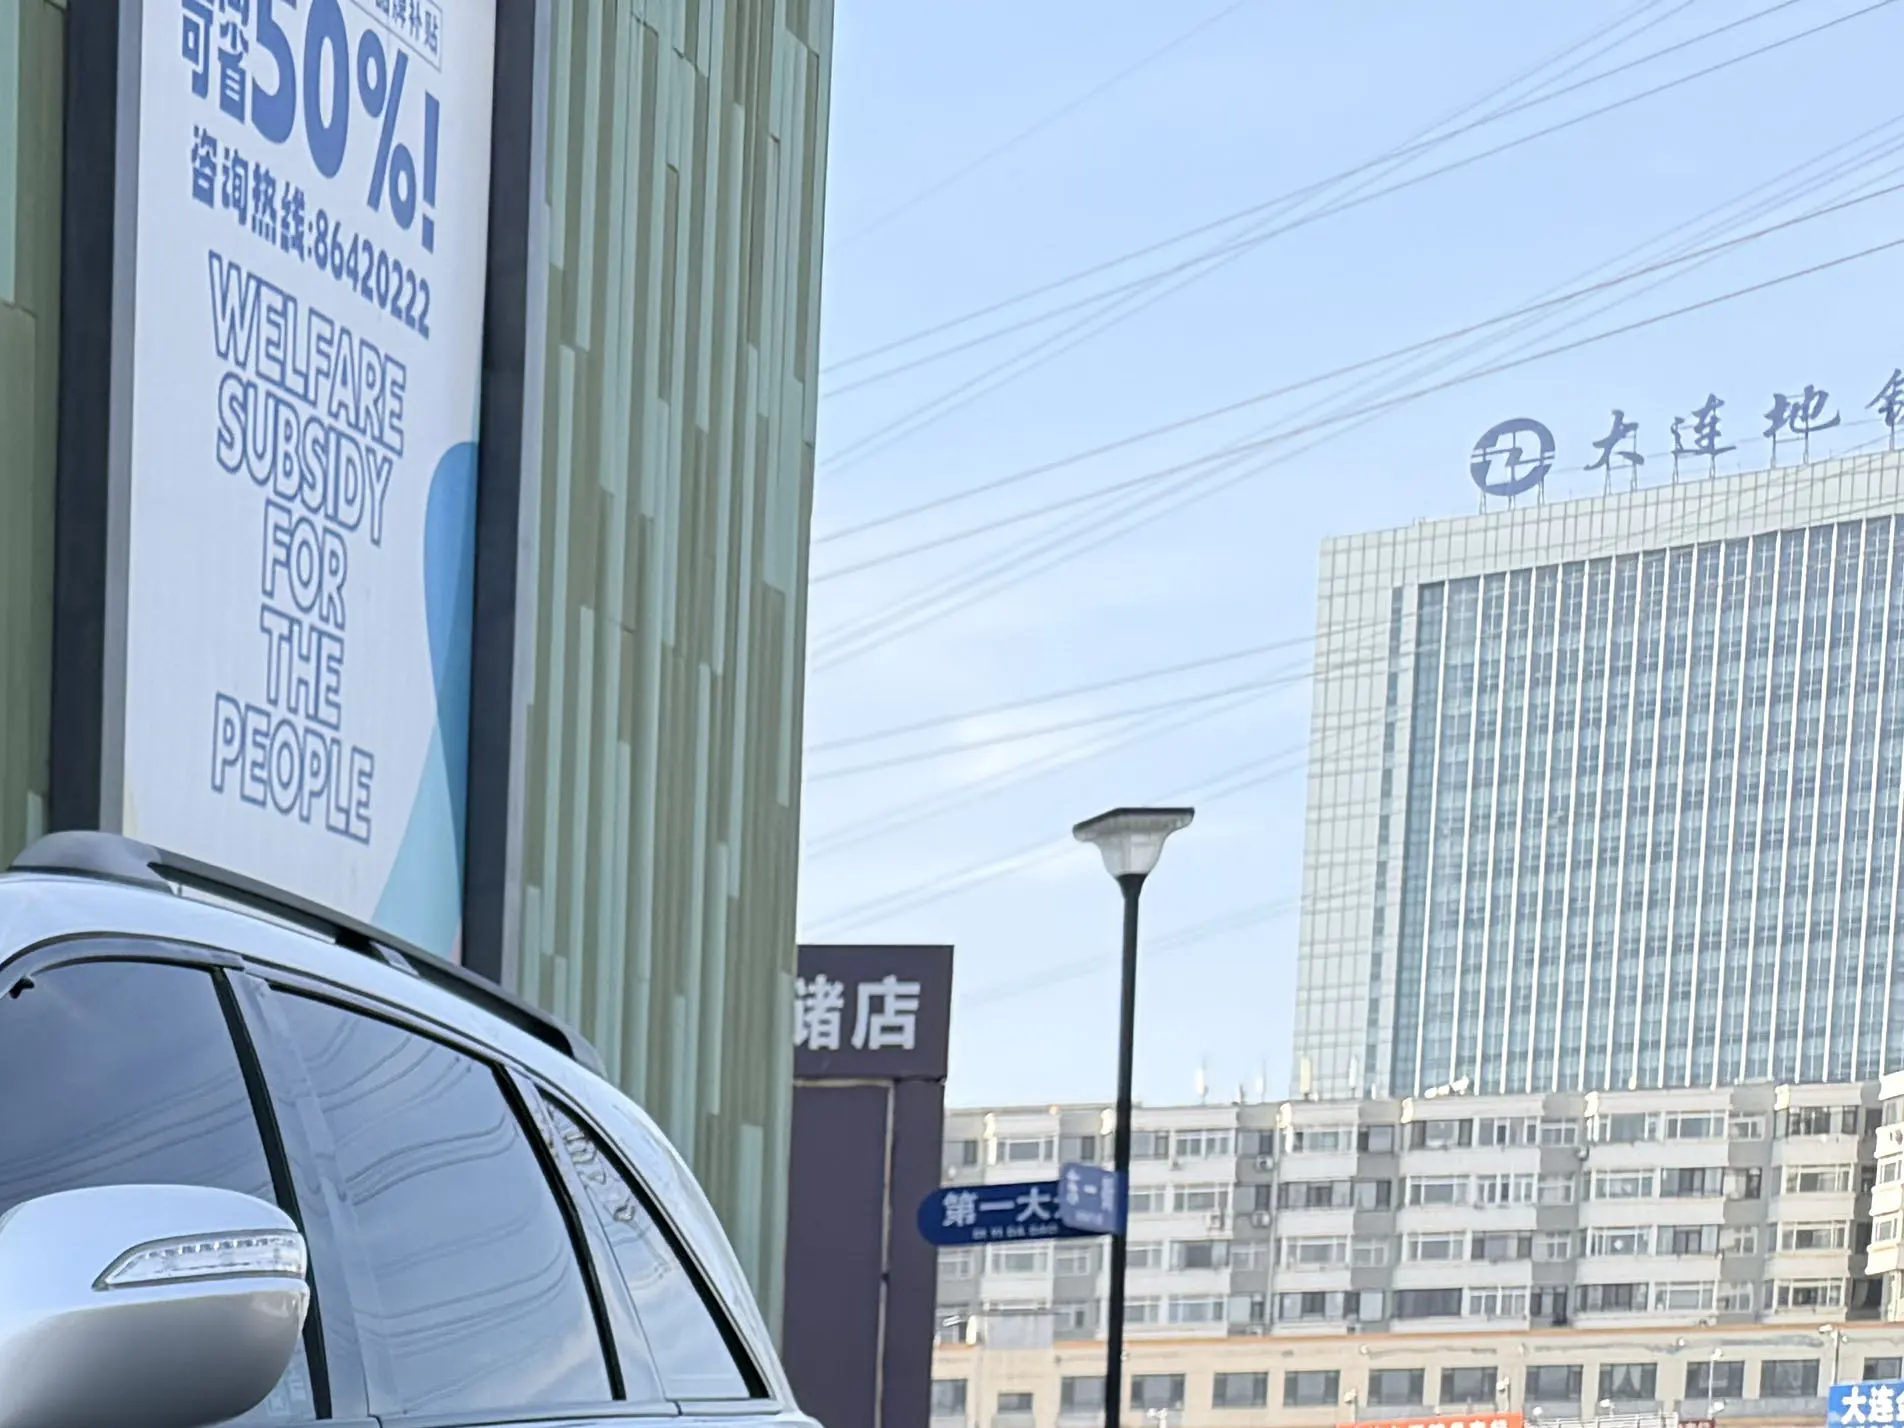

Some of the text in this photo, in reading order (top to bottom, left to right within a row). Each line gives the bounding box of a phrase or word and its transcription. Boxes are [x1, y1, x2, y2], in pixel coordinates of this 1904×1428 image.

[207, 250, 407, 457] WELFARE
[216, 370, 392, 548] SUBSIDY
[261, 496, 348, 631] FOR
[259, 608, 345, 732] THE
[211, 694, 375, 846] PEOPLE
[942, 1185, 1063, 1228] 第一大
